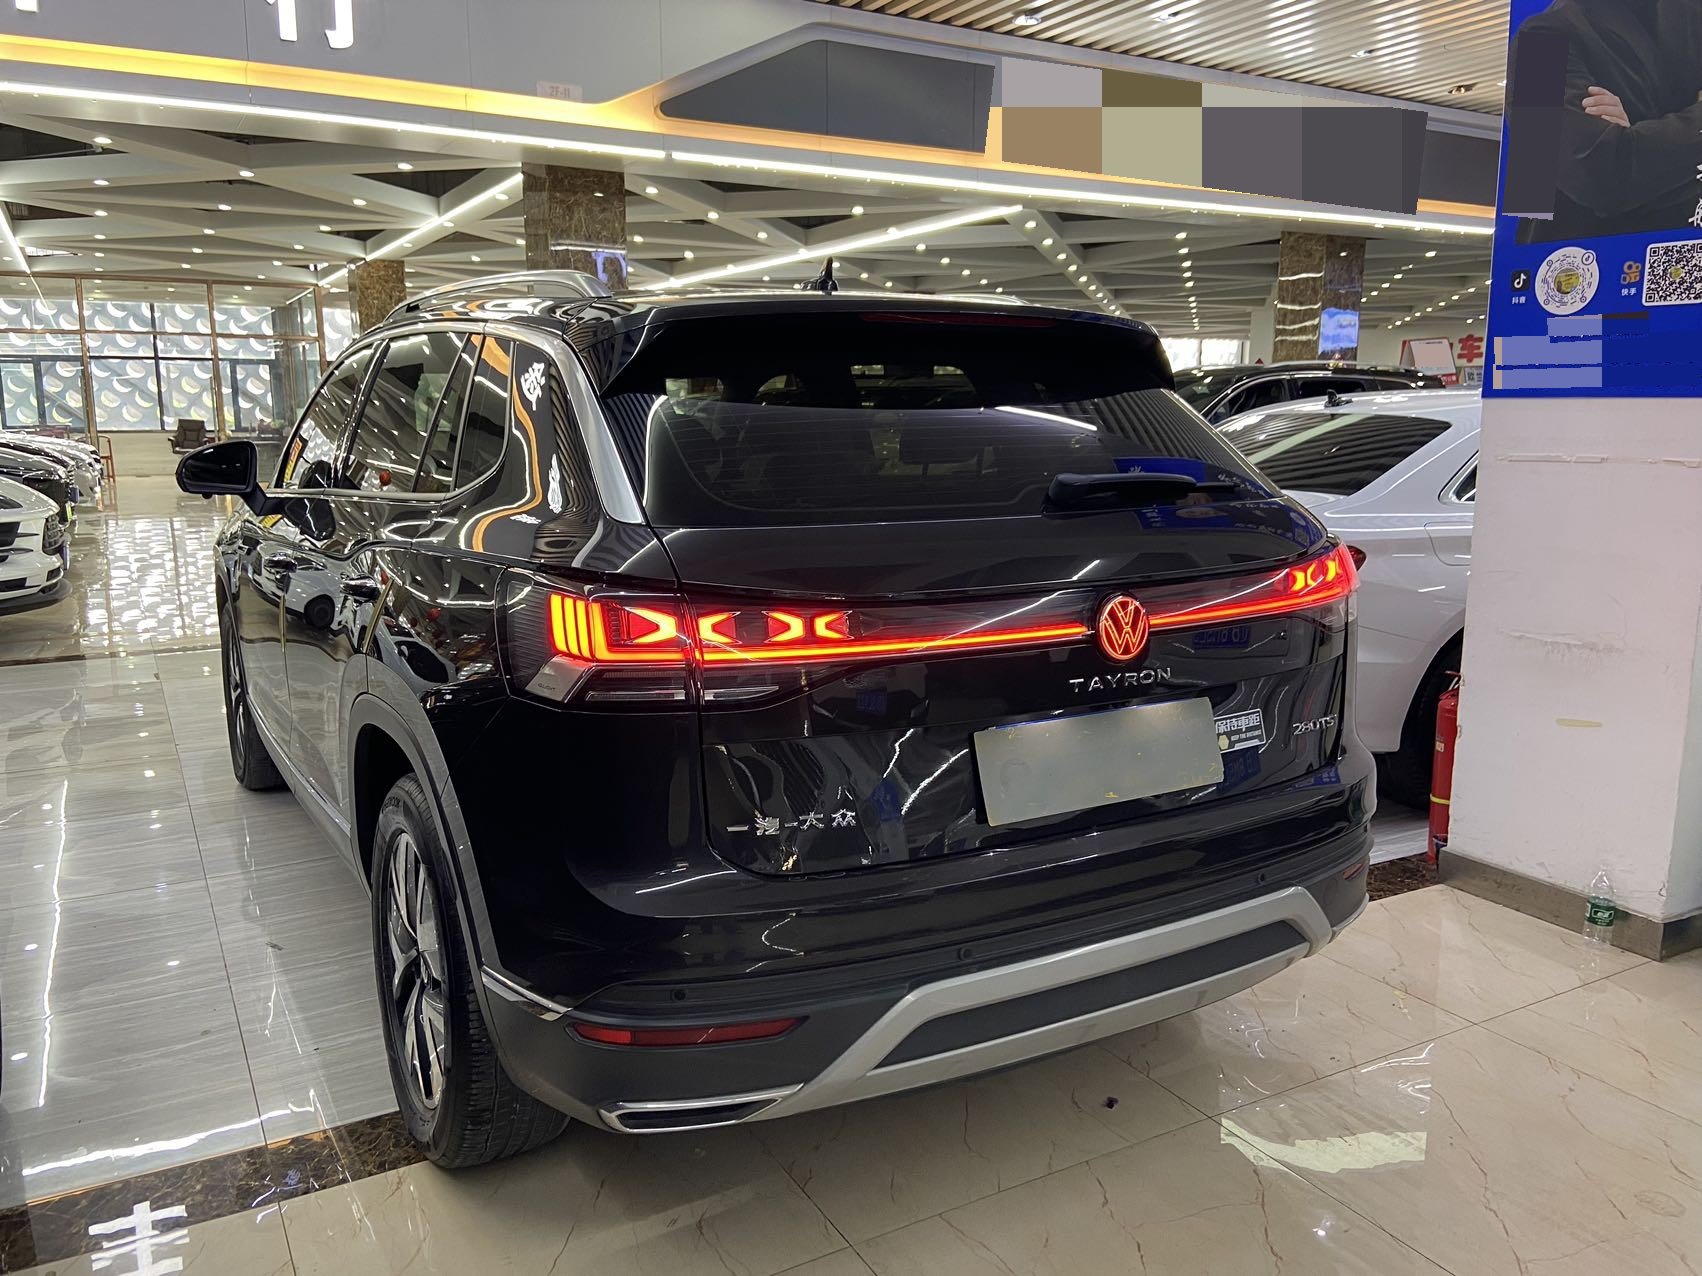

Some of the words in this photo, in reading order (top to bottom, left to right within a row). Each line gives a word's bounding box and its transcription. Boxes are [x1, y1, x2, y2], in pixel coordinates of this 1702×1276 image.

[1621, 287, 1637, 297] 快手
[1457, 334, 1484, 363] 车
[1069, 667, 1171, 692] TAYRON
